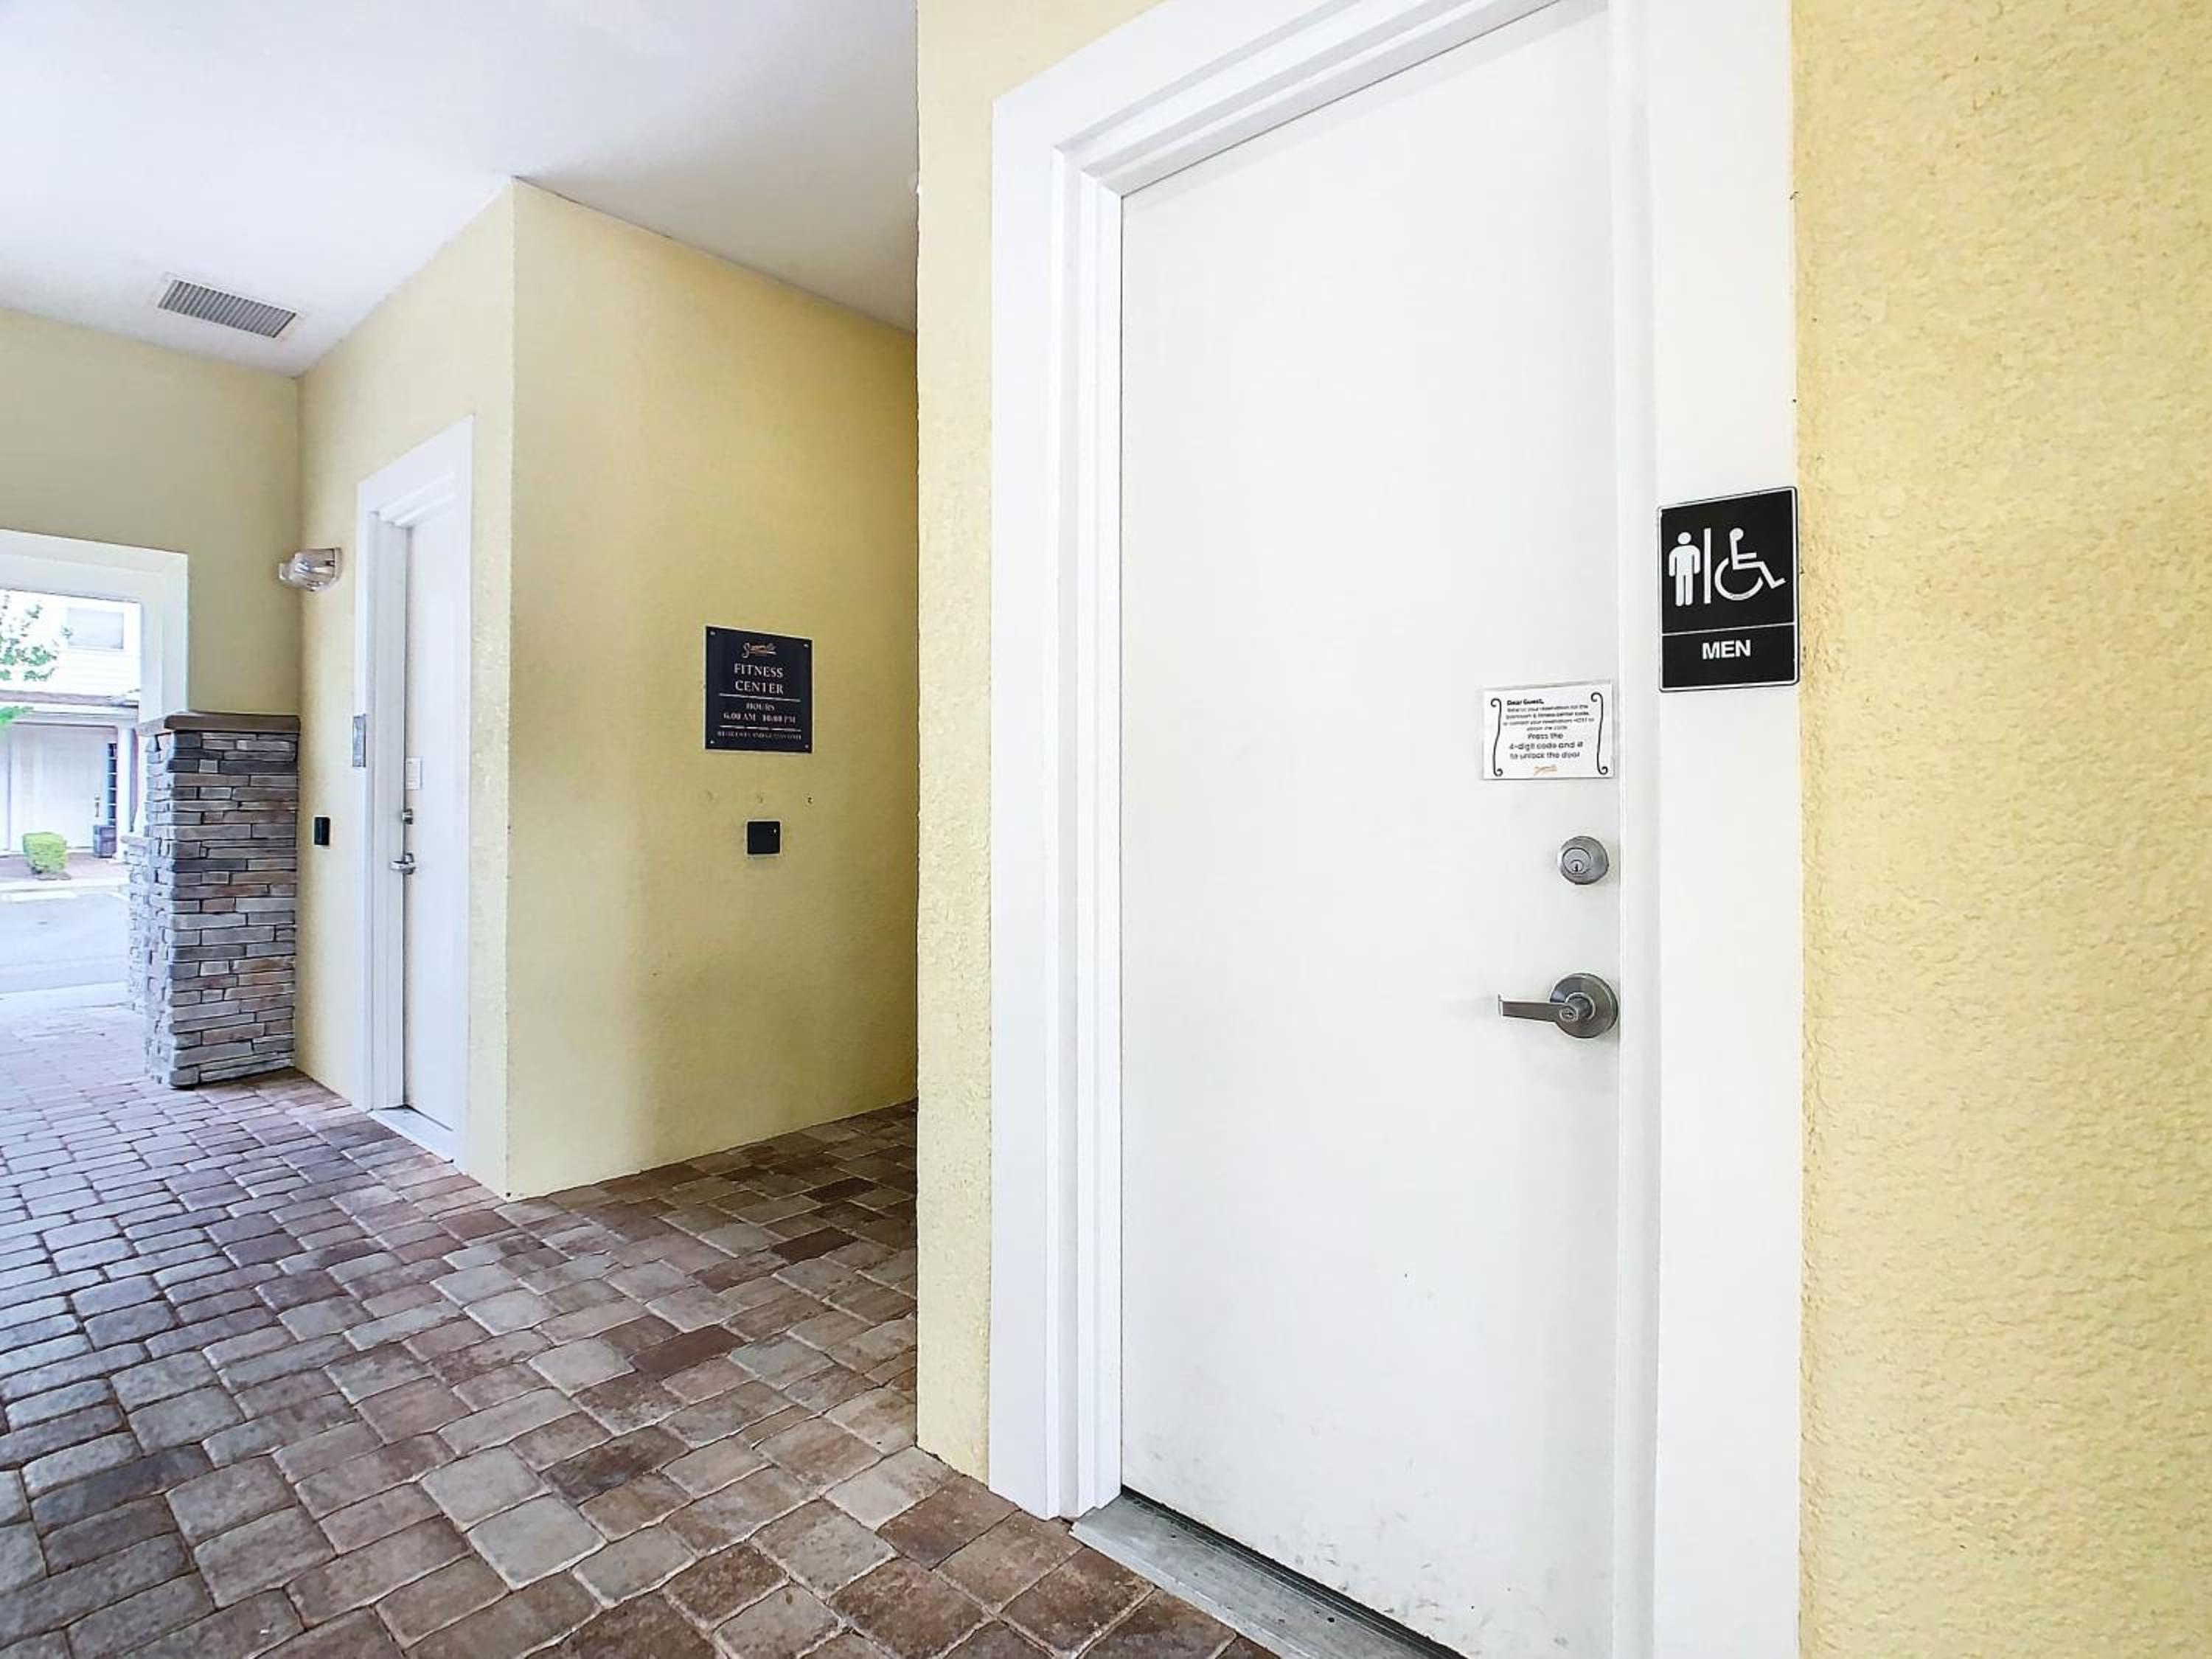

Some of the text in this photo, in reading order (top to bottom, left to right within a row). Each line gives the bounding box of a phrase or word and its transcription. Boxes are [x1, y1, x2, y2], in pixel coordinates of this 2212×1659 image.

[1703, 639, 1751, 660] MEN
[734, 664, 783, 678] FITNESS
[735, 680, 784, 694] CENTER
[745, 702, 775, 711] HOURS
